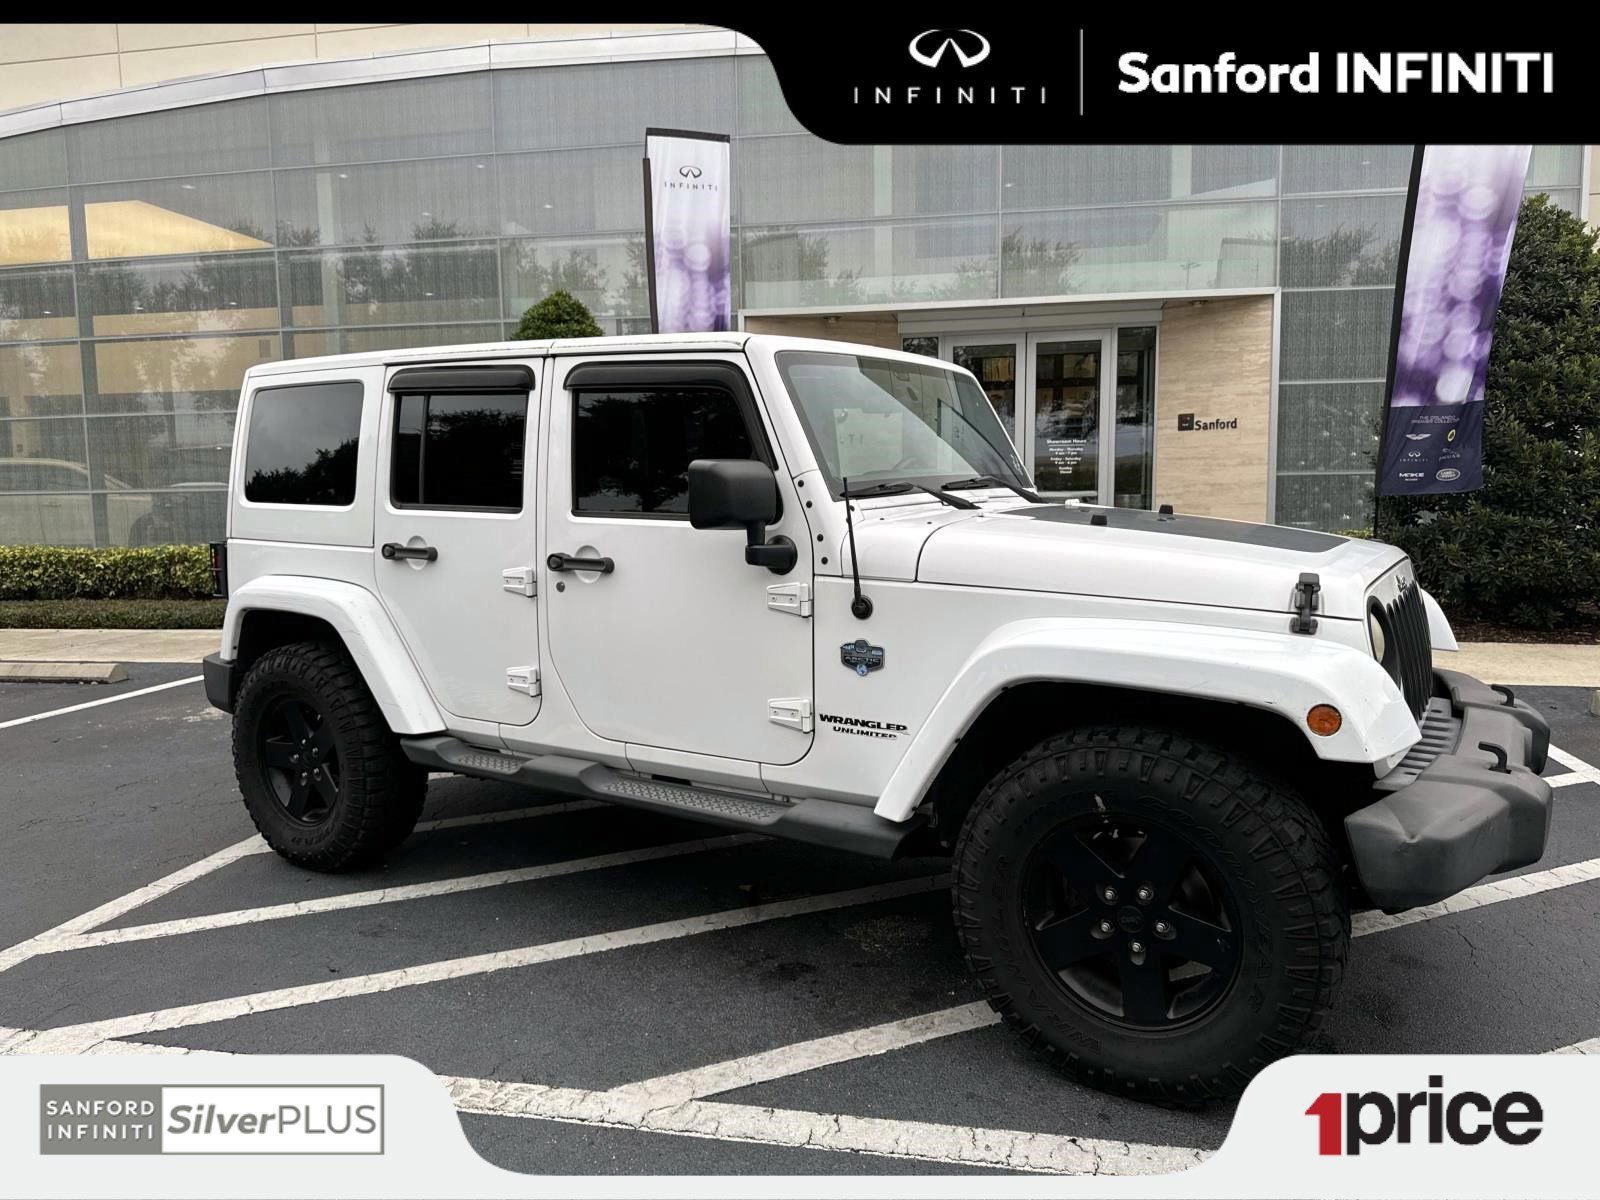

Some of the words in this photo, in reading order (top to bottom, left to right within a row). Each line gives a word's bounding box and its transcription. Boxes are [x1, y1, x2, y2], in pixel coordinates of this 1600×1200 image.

[664, 181, 718, 192] INFINITI
[1194, 417, 1238, 431] Sanford
[819, 713, 909, 733] WRANGLER
[833, 725, 898, 739] UNLIMITED
